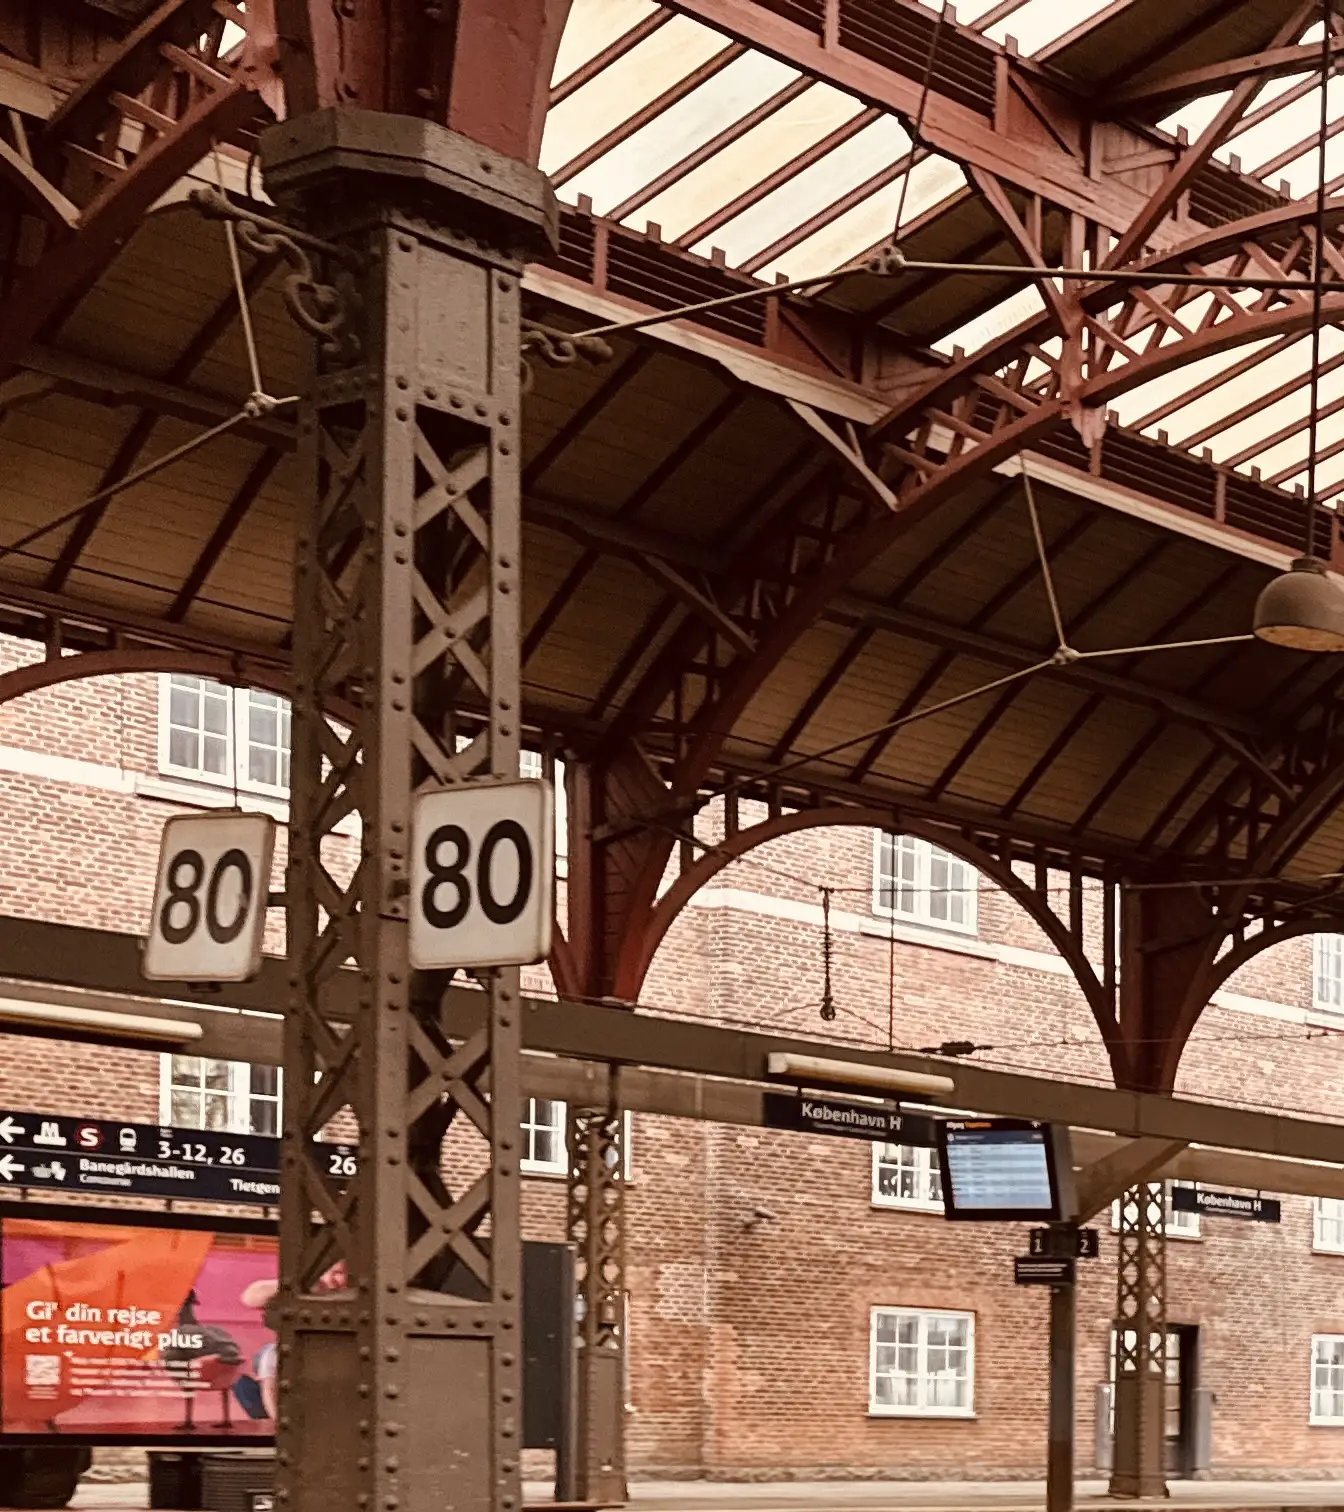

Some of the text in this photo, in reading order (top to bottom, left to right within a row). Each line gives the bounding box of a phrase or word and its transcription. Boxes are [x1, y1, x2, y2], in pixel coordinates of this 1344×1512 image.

[422, 819, 533, 929] 80
[160, 848, 254, 945] 80
[801, 1101, 886, 1128] København
[889, 1115, 902, 1130] H
[79, 1127, 99, 1147] S
[157, 1140, 246, 1166] 3-12, 26
[328, 1154, 357, 1176] 26
[229, 1178, 281, 1195] Tietgen
[1253, 1199, 1262, 1212] H
[1034, 1238, 1043, 1253] 1
[1080, 1238, 1091, 1254] 2
[65, 1302, 101, 1323] din
[107, 1305, 162, 1327] rejse
[25, 1324, 203, 1351] et farverigt plus
